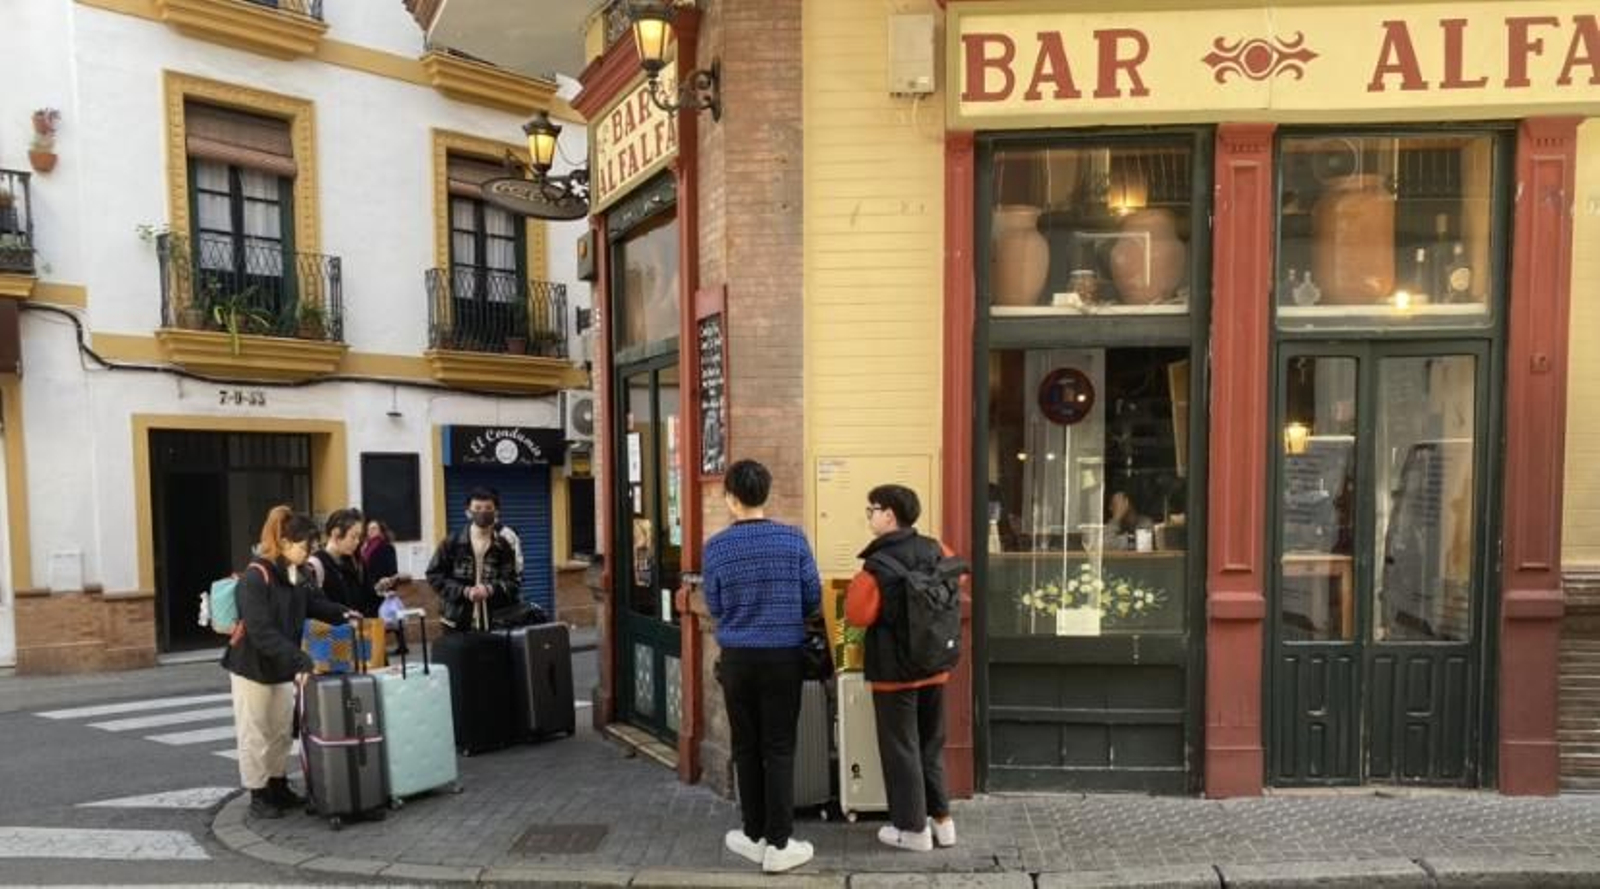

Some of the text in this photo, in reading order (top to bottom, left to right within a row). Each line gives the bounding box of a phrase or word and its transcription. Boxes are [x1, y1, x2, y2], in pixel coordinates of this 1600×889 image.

[961, 14, 1600, 103] BAR ALFA
[598, 115, 678, 197] ALFALFA
[612, 87, 652, 145] BAR
